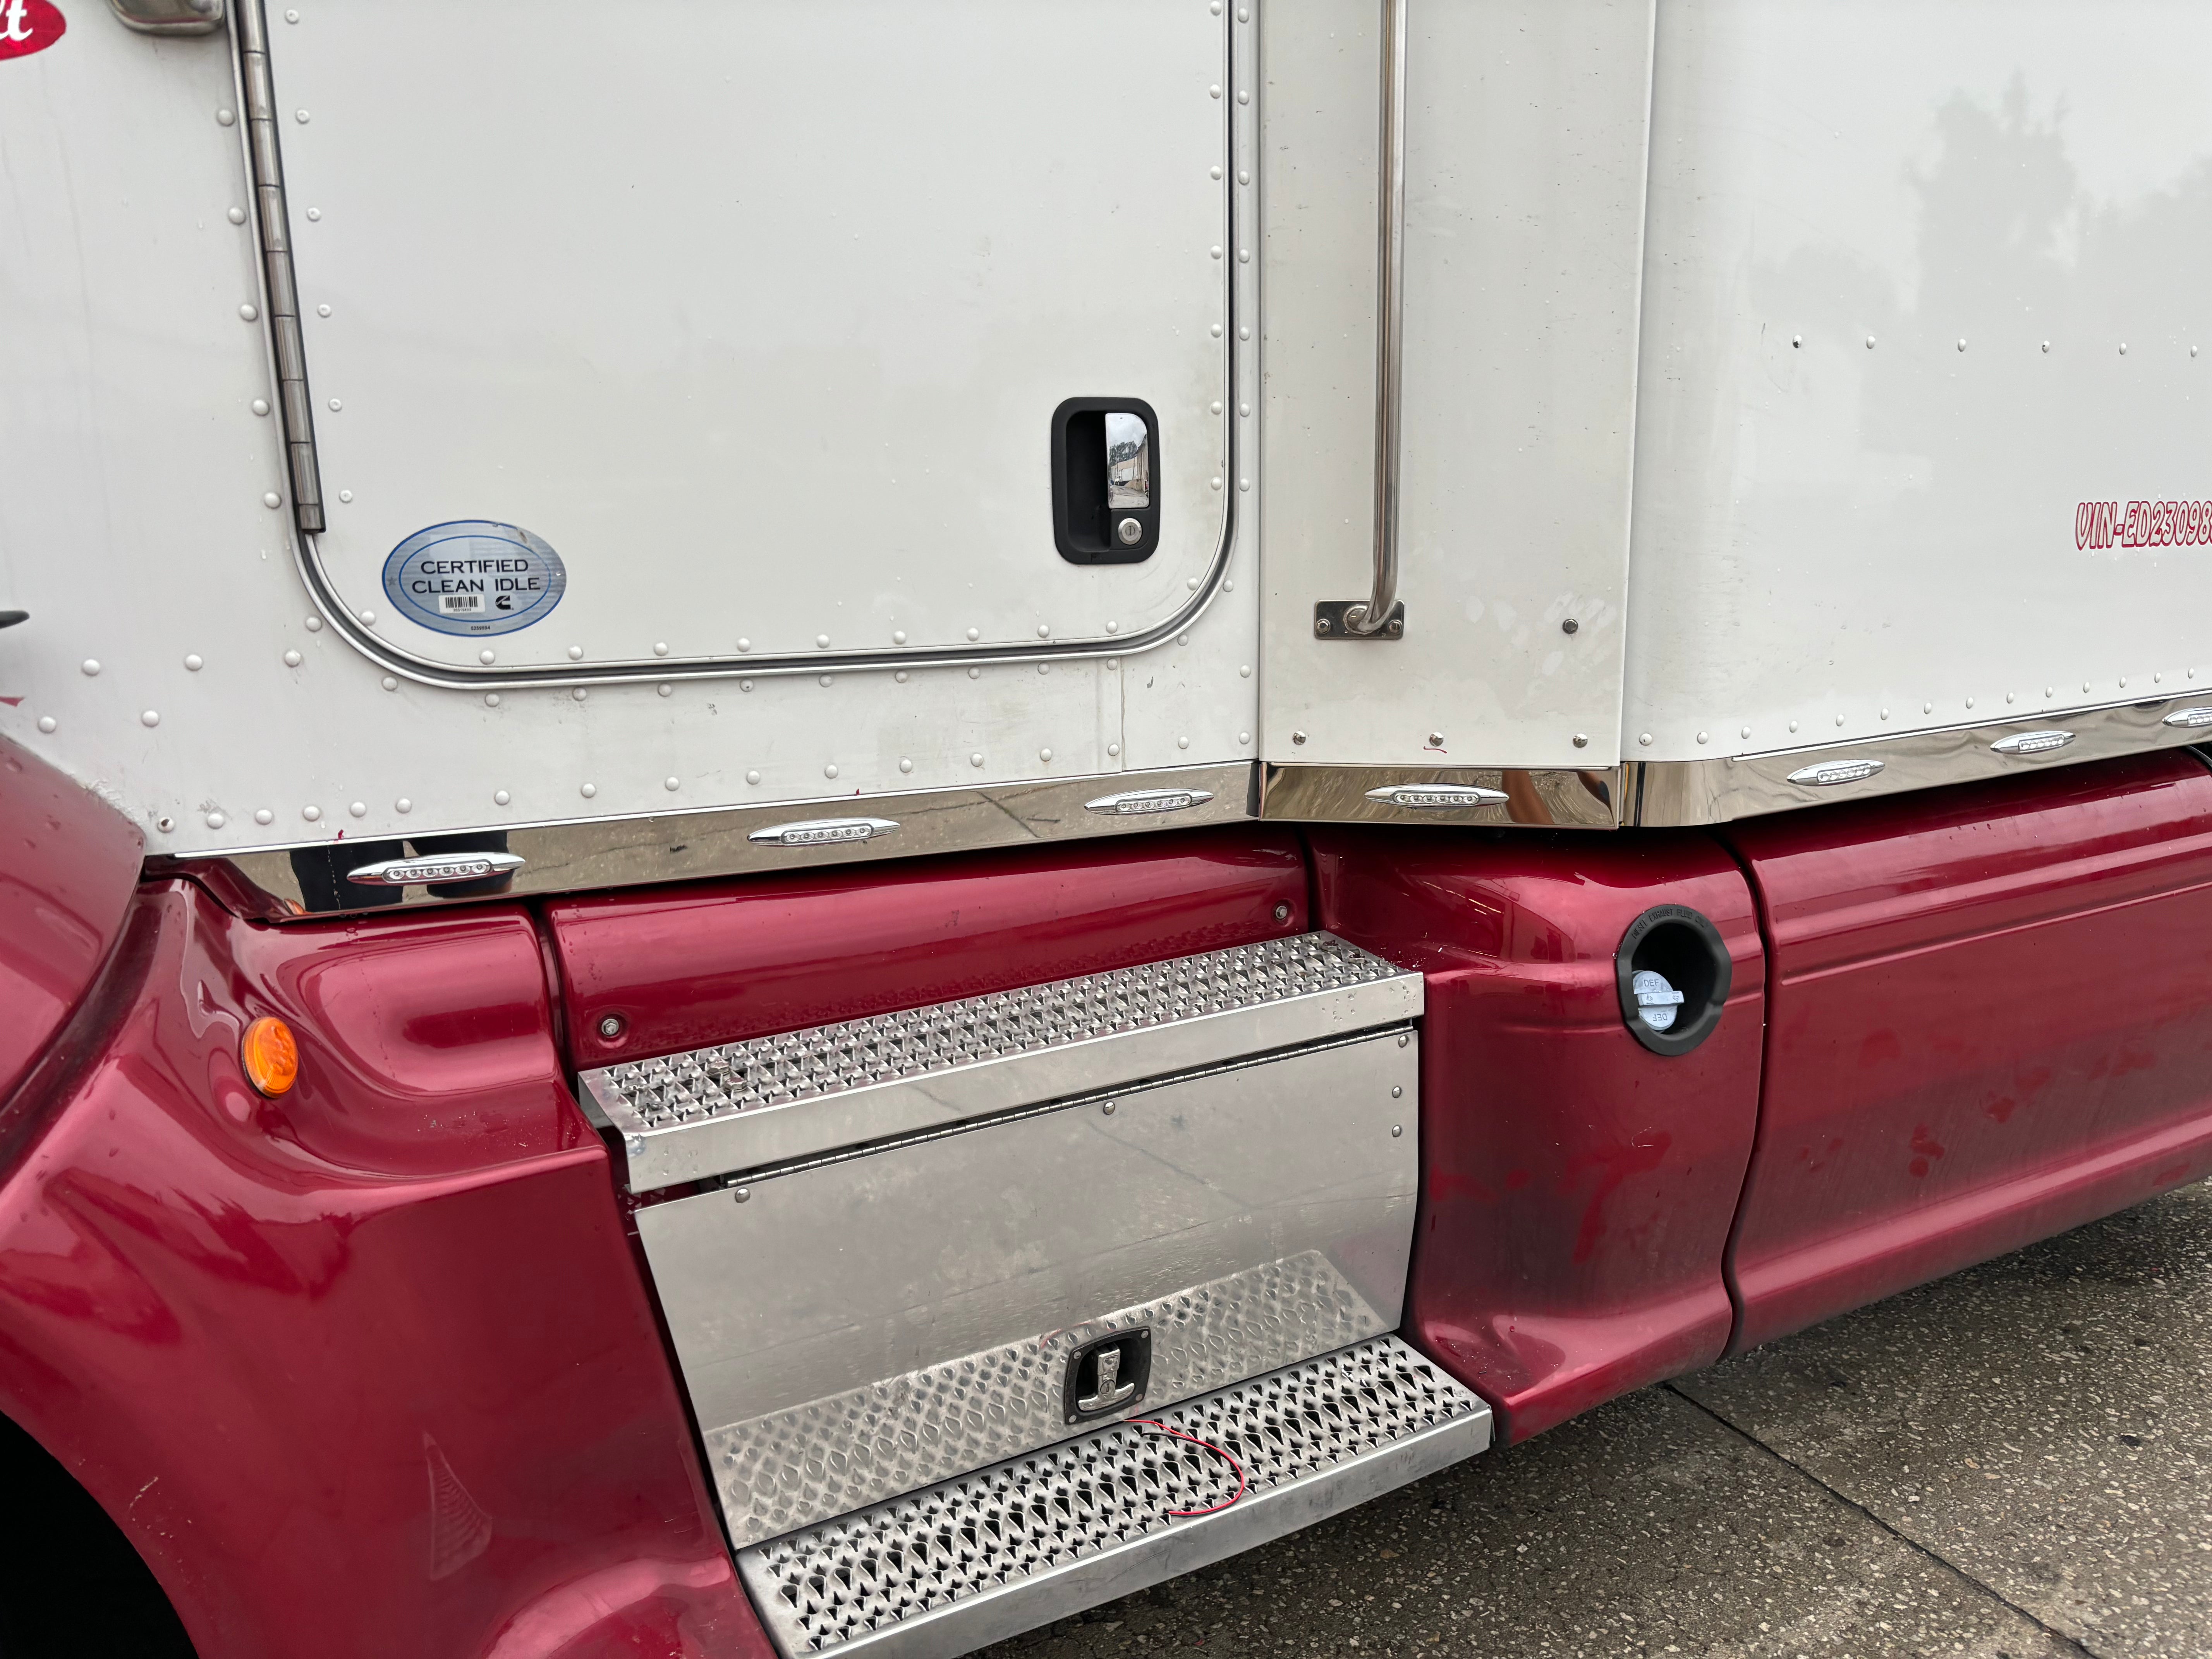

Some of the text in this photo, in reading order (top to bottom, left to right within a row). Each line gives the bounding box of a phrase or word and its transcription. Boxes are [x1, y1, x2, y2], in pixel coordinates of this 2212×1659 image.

[2075, 500, 2212, 551] VIN-ED23098
[421, 559, 528, 574] CERTIFIED
[412, 577, 541, 594] CLEAN IDLE
[1648, 908, 1673, 922] EXHAUST
[1676, 908, 1692, 919] FLUID
[1644, 979, 1659, 987] DEF
[1652, 1013, 1668, 1022] DEF
